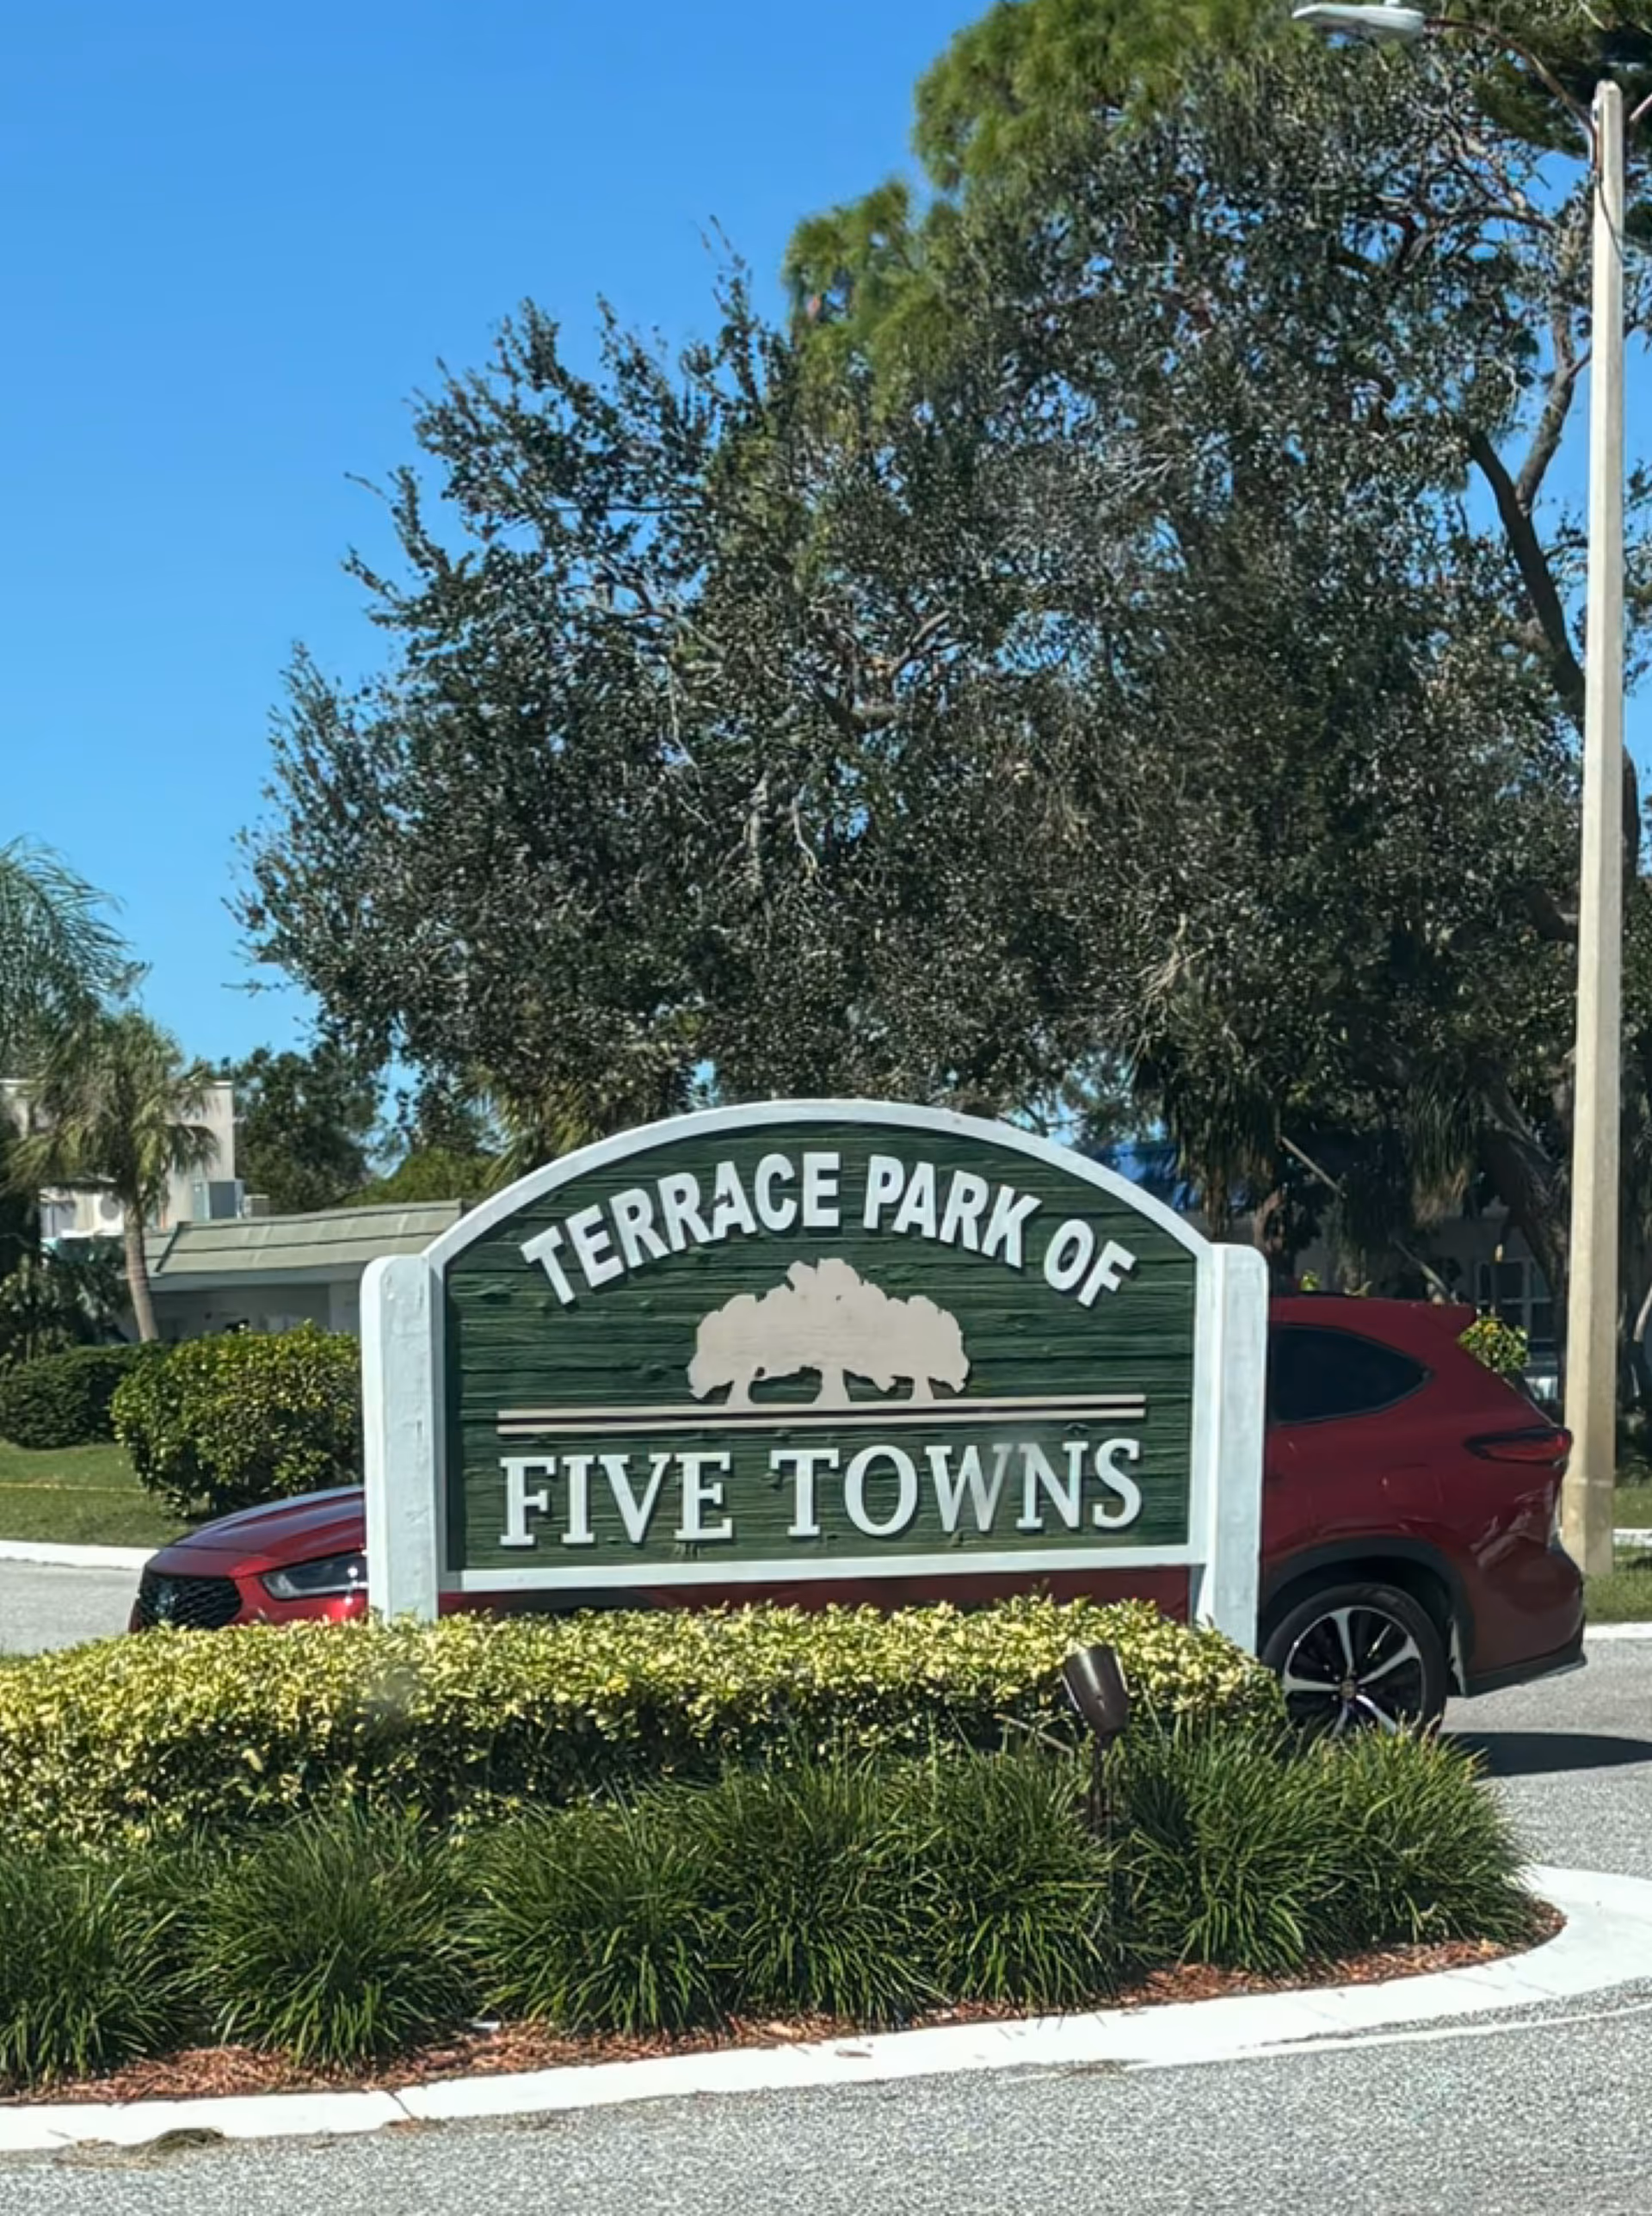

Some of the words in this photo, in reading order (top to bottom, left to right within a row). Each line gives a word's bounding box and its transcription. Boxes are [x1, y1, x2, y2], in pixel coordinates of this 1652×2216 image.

[521, 1151, 841, 1304] TERRACE
[864, 1155, 1042, 1268] PARK
[1044, 1219, 1137, 1306] OF
[499, 1453, 734, 1546] FIVE
[769, 1439, 1143, 1537] TOWNS
